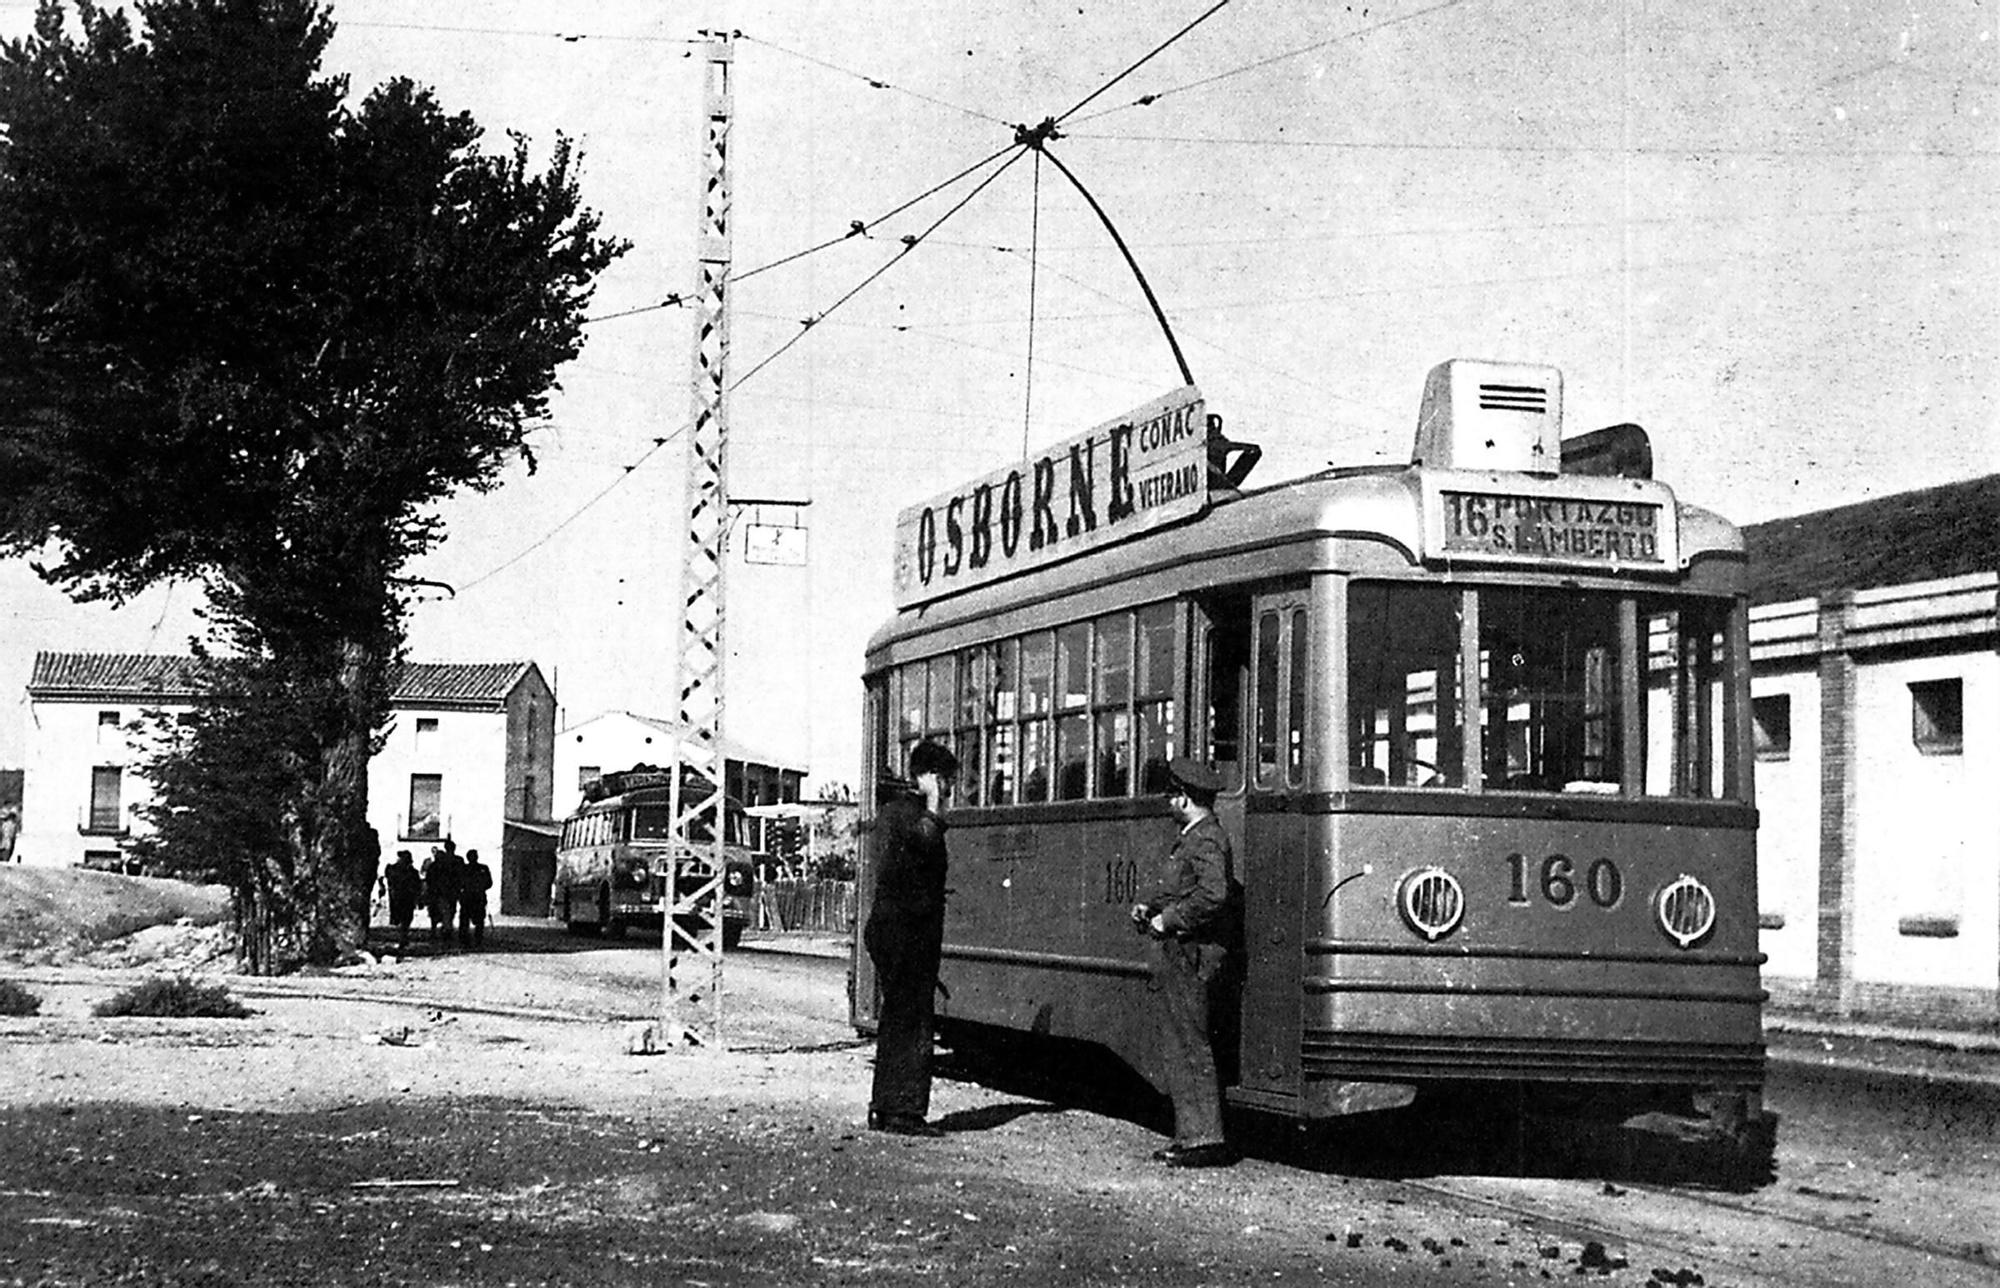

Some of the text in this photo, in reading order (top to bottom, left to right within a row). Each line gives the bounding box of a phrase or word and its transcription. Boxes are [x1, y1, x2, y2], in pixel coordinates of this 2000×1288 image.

[917, 423, 1136, 586] OSBORNE
[1139, 463, 1198, 509] VETERANO
[1448, 495, 1655, 537] 16 PORTAZGO
[1105, 860, 1137, 904] 160
[1505, 852, 1625, 910] 160
